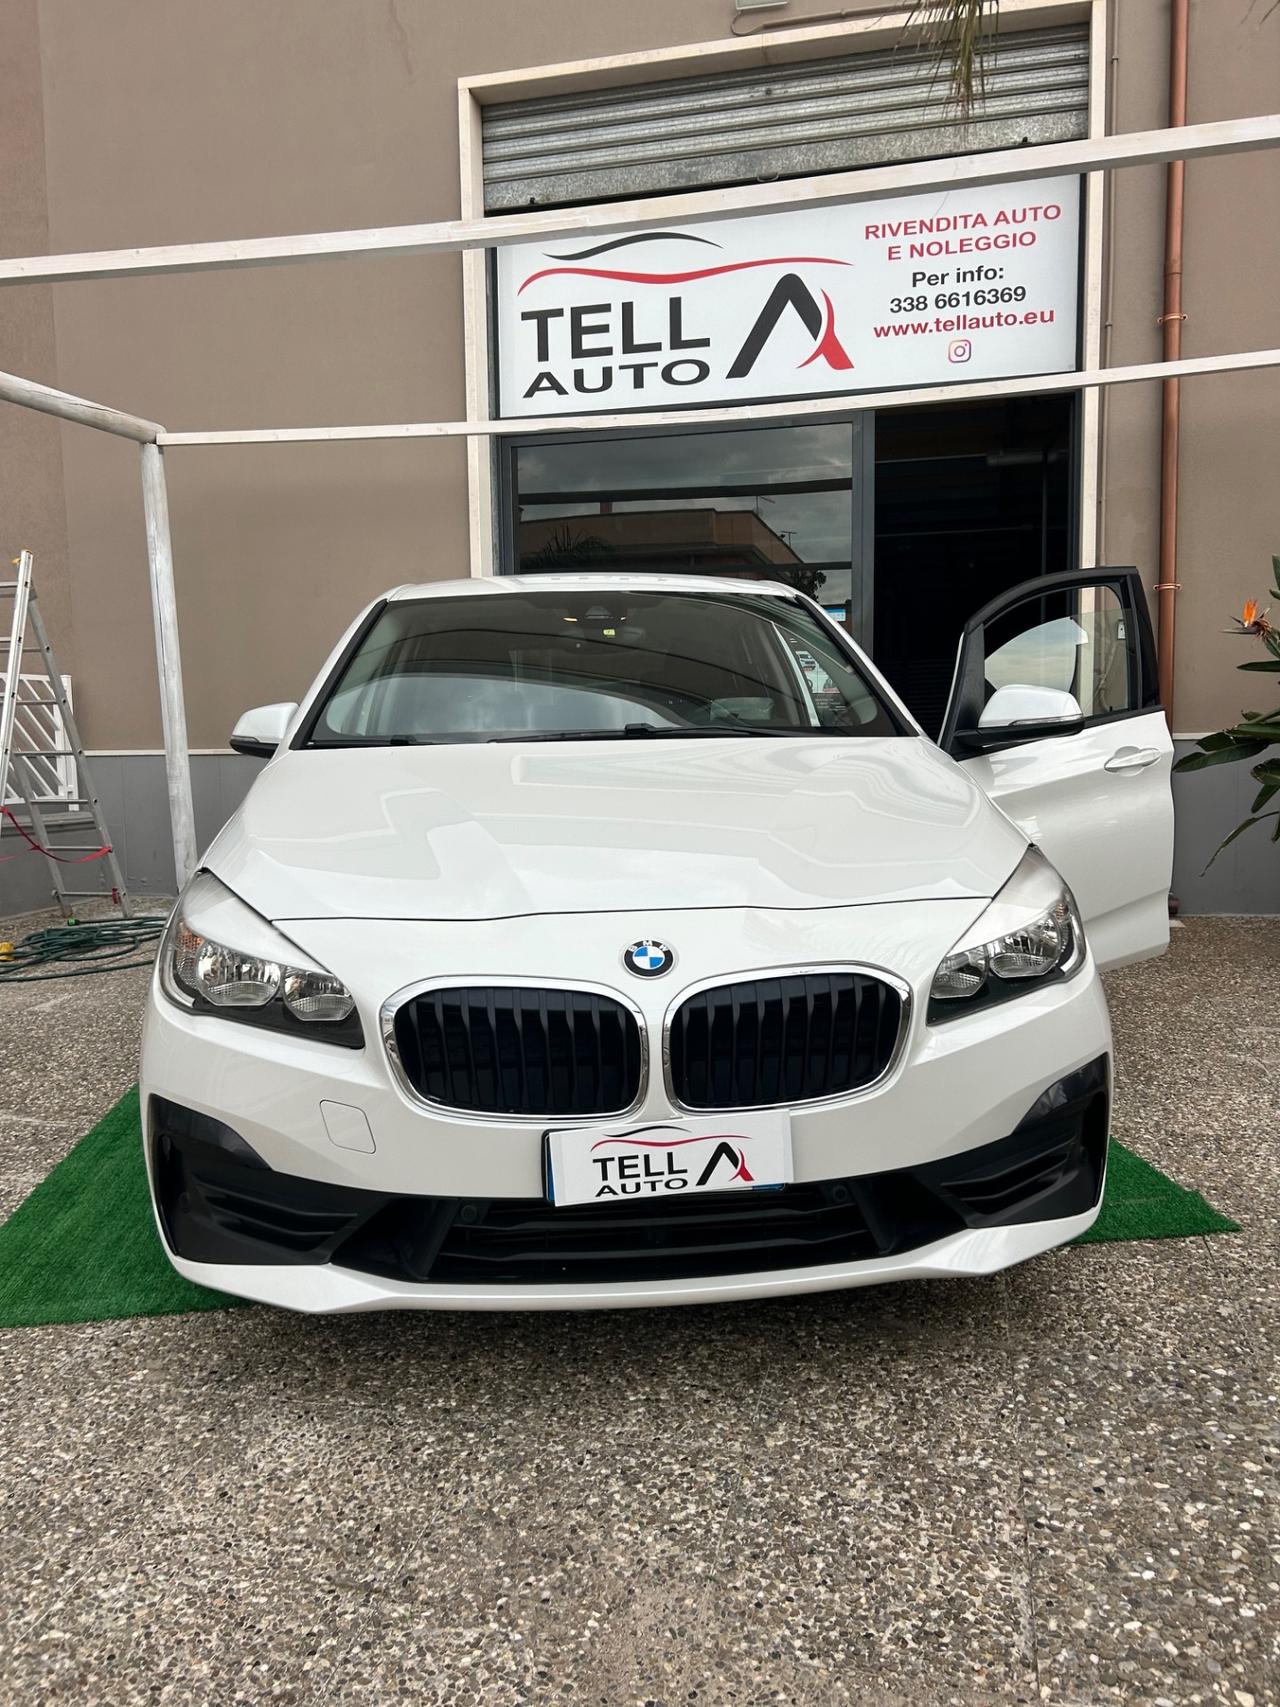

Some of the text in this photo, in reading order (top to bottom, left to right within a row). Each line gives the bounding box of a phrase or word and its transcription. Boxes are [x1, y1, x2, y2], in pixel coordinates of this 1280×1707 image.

[865, 204, 1062, 240] RIVENDITA AUTO
[887, 231, 1037, 261] E NOLEGGIO
[912, 265, 1004, 287] Per info:
[890, 286, 1027, 313] 338 6616369
[521, 296, 711, 362] TELL
[873, 309, 1055, 338] www.tellauto.eu
[522, 358, 711, 399] AUTO
[592, 1151, 688, 1181] TELL
[595, 1177, 688, 1197] AUTO
